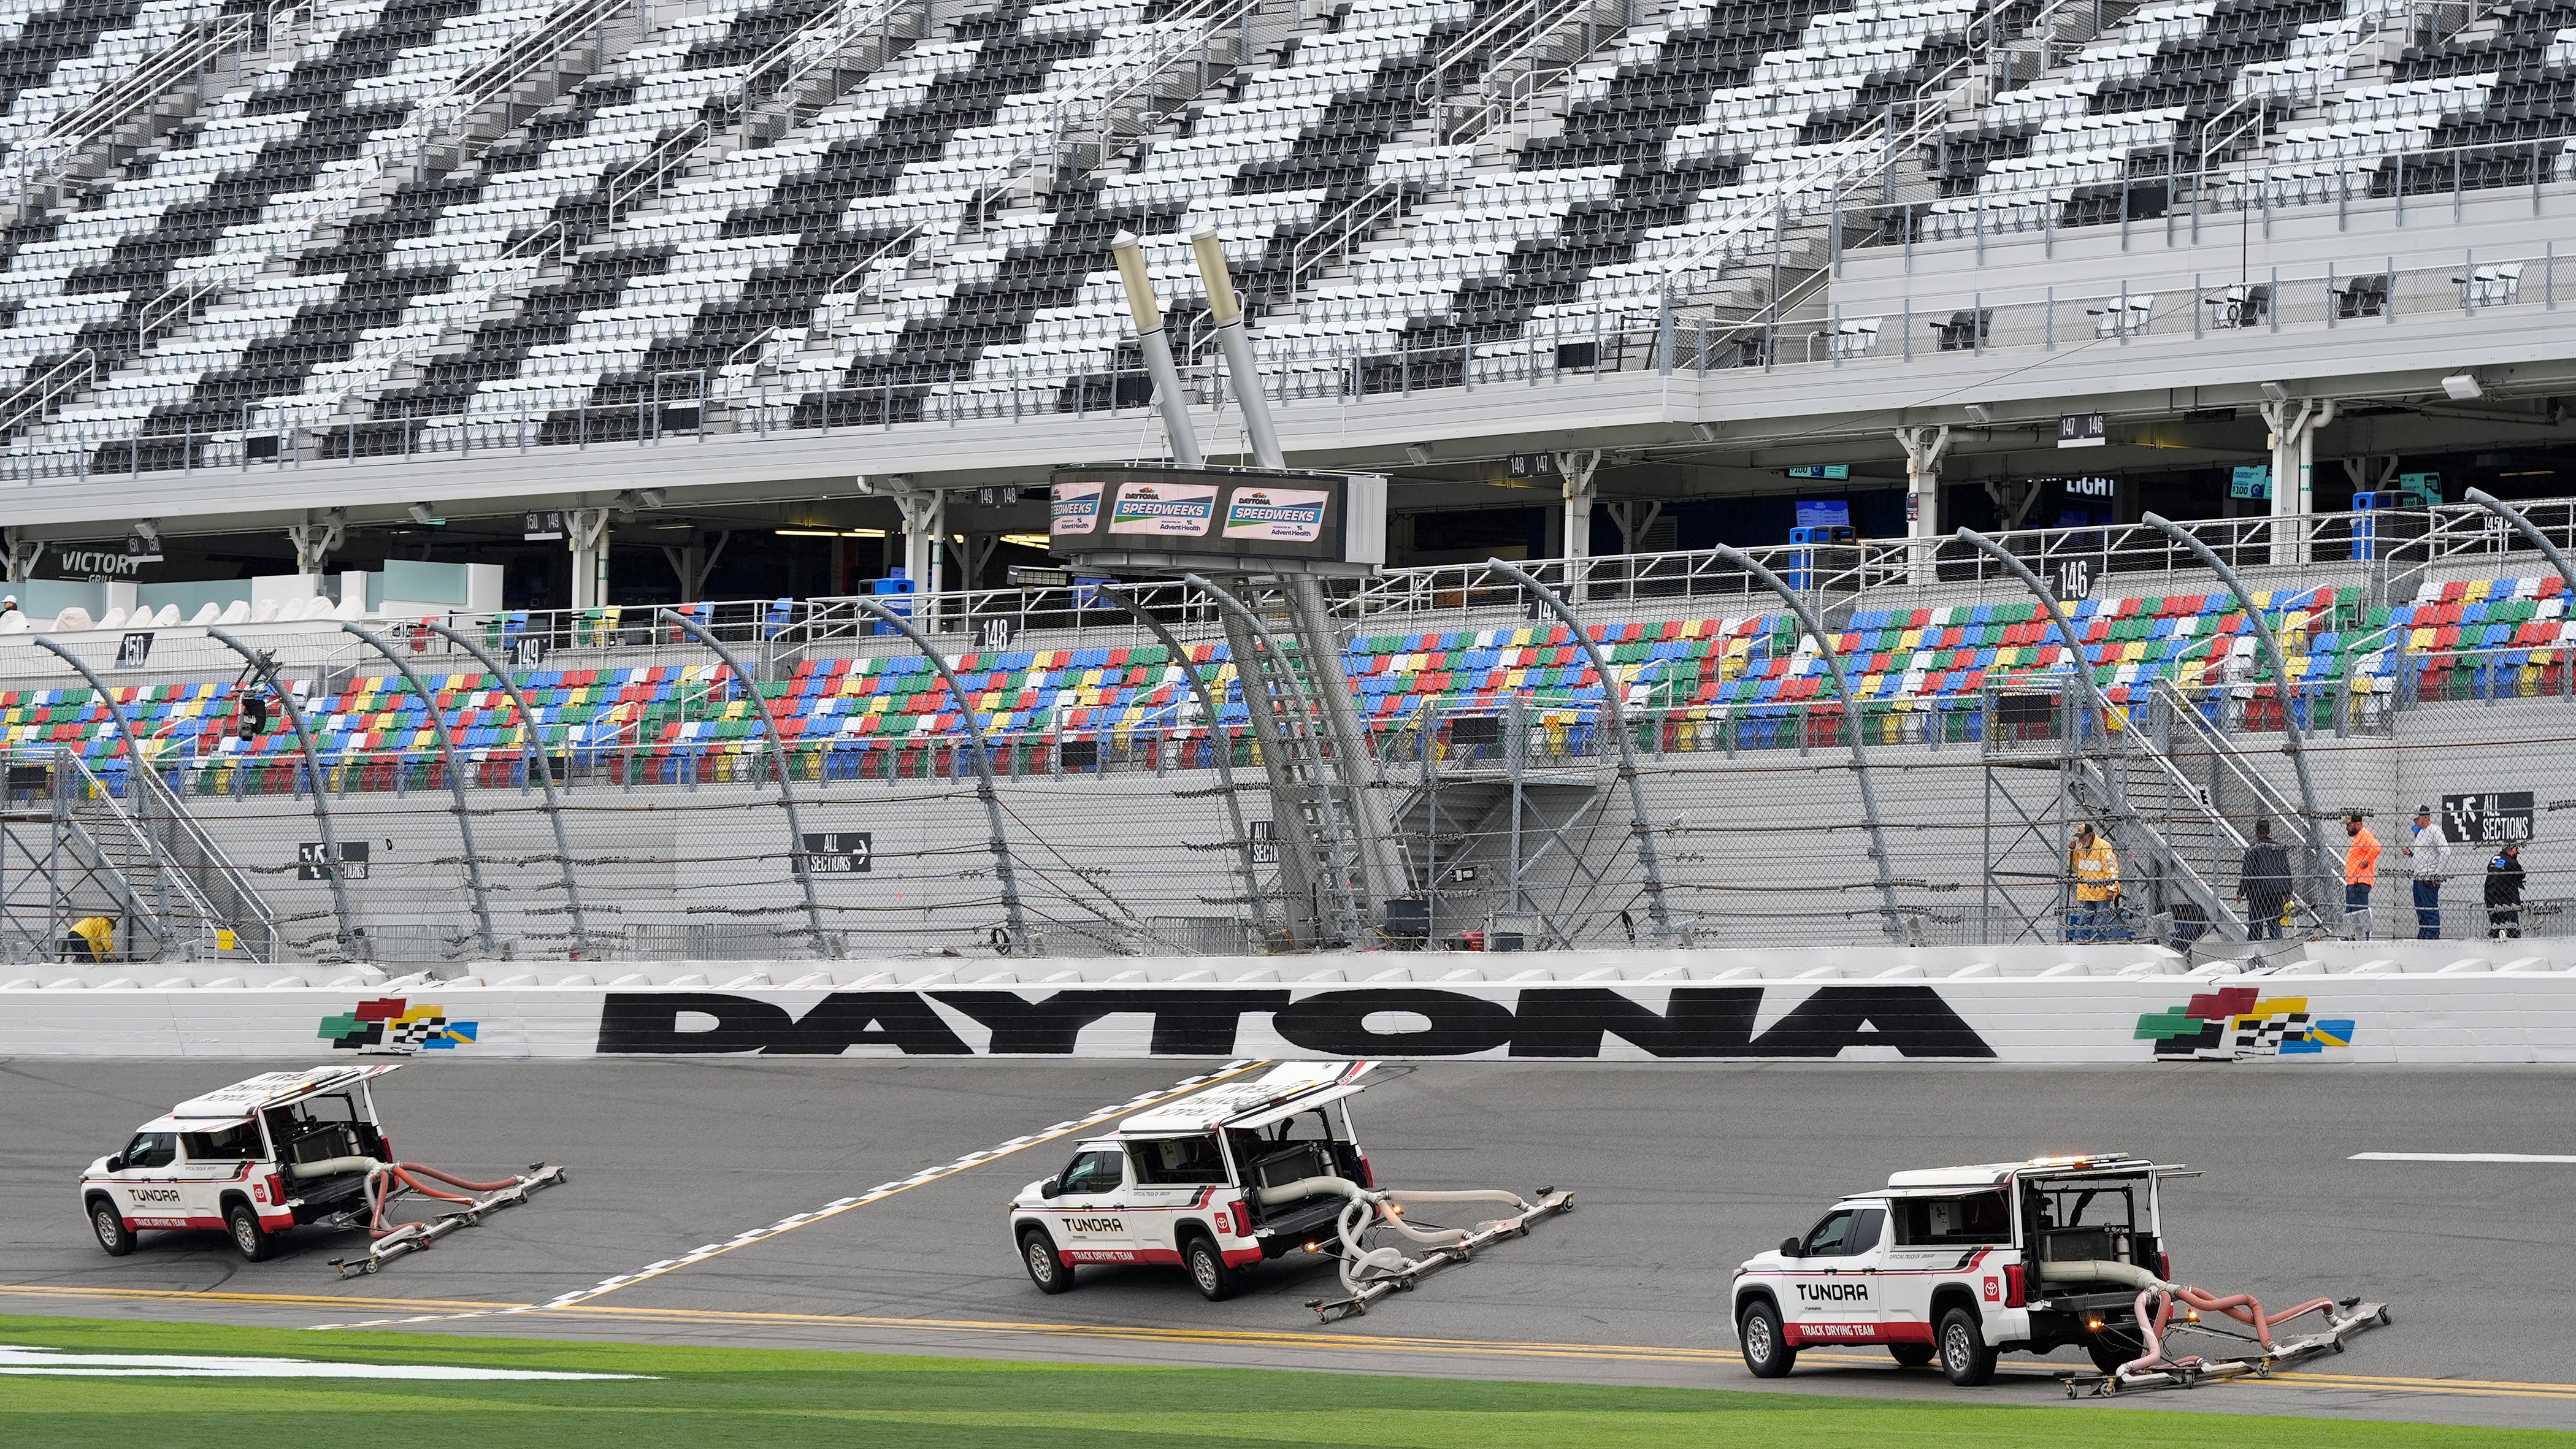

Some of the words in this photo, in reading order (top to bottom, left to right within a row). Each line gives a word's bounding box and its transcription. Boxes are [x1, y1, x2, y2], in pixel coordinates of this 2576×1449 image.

[2063, 418, 2076, 435] 147
[2088, 415, 2103, 434] 146
[1511, 456, 1525, 473] 148
[1535, 455, 1547, 472] 147
[980, 487, 993, 504] 149
[1003, 487, 1016, 503] 148
[2232, 486, 2248, 495] $100
[1122, 502, 1205, 516] SPEEDWEEKS
[1235, 507, 1316, 522] SPEEDWEEKS
[526, 513, 539, 530] 150
[546, 513, 559, 529] 149
[128, 538, 139, 552] 151
[147, 537, 159, 551] 150
[63, 551, 140, 575] VICTORY
[2060, 560, 2087, 599] 146
[983, 619, 1008, 652] 148
[125, 635, 144, 665] 150
[516, 638, 539, 670] 149
[2199, 790, 2209, 805] E
[2483, 794, 2501, 817] ALL
[1254, 822, 1267, 841] ALL
[2482, 816, 2528, 840] SECTIONS
[385, 838, 393, 851] D
[823, 834, 839, 852] ALL
[810, 854, 851, 872] SECTIONS
[597, 986, 1995, 1056] DAYTONA
[128, 1189, 180, 1202] TUNDRA
[1061, 1218, 1124, 1232] TUNDRA
[1071, 1252, 1093, 1260] TRACK
[1092, 1252, 1117, 1260] DRYING
[1114, 1252, 1135, 1260] TEAM
[1796, 1284, 1868, 1301] TUNDRA
[1800, 1325, 1826, 1336] TRACK
[1825, 1325, 1853, 1336] DRYING
[1852, 1325, 1875, 1336] TEAM
